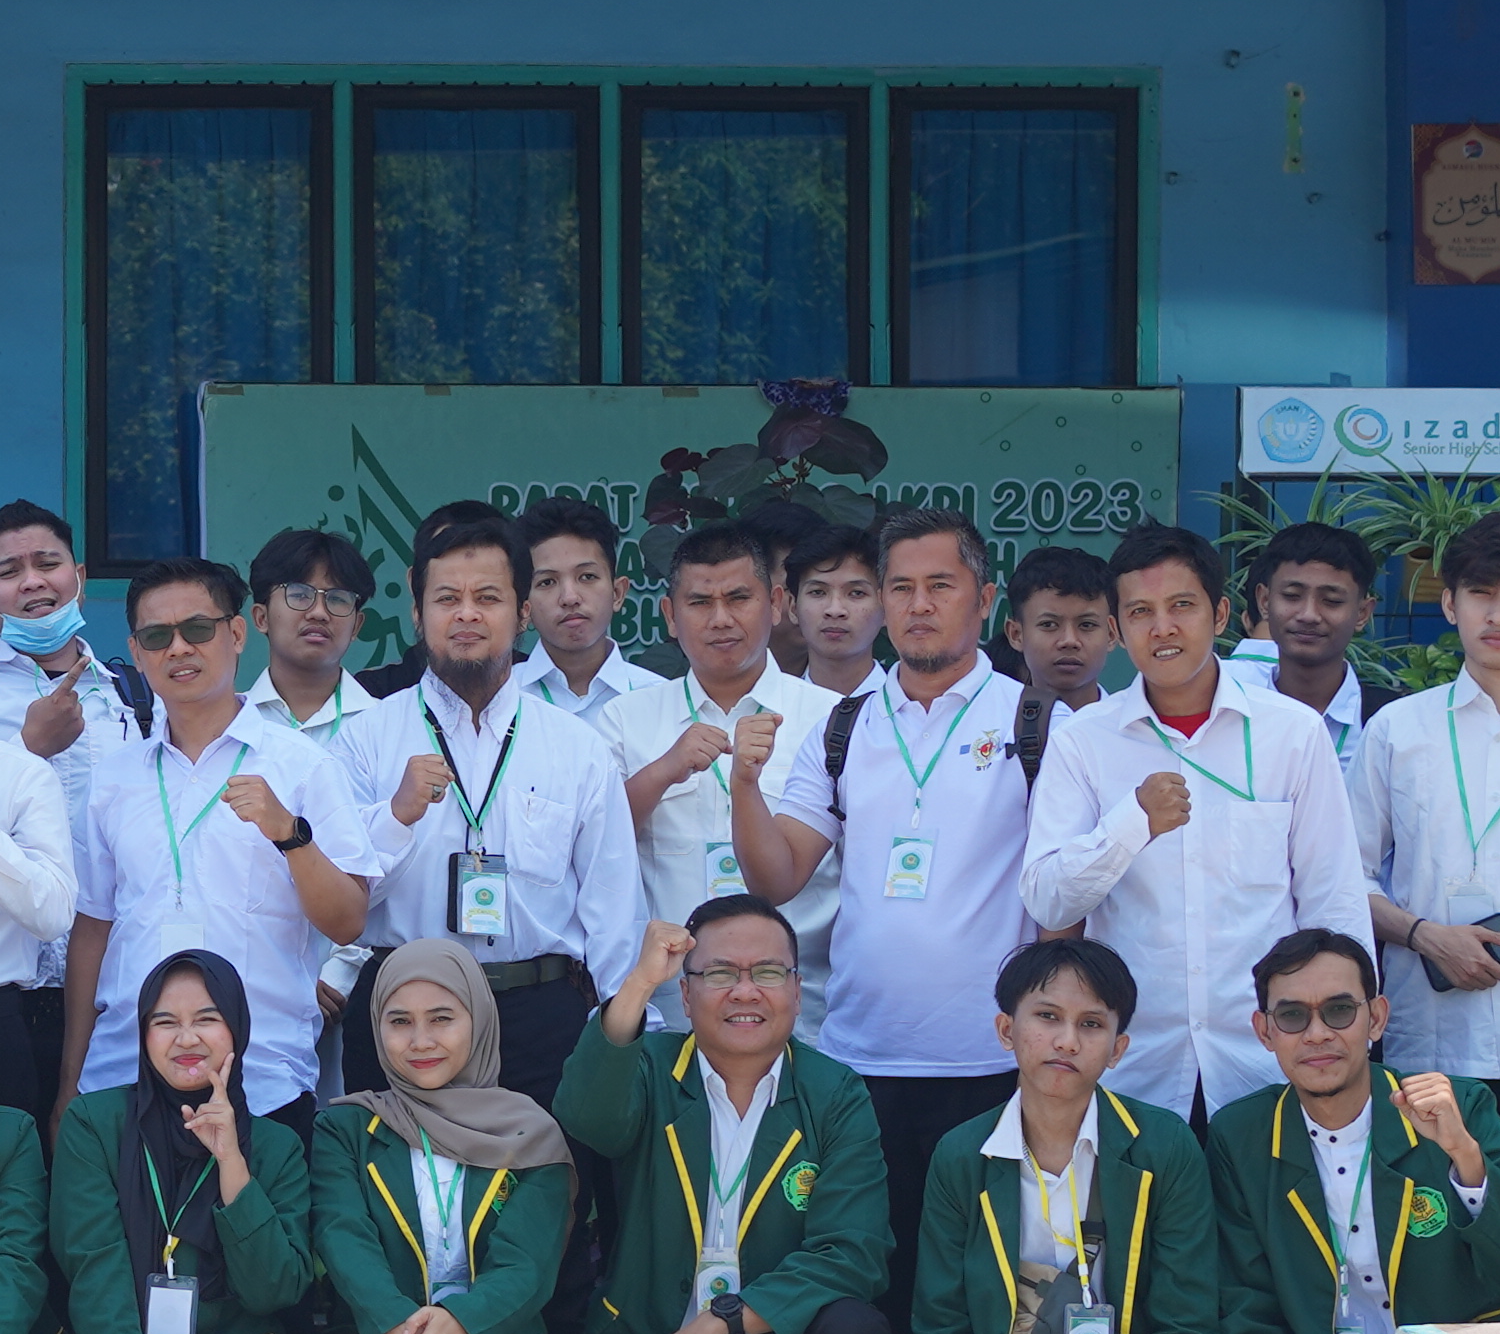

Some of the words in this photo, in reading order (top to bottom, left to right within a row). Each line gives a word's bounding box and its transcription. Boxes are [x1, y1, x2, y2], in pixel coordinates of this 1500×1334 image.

[1403, 442, 1446, 455] Senior
[1449, 442, 1480, 457] High
[992, 480, 1145, 533] 2023
